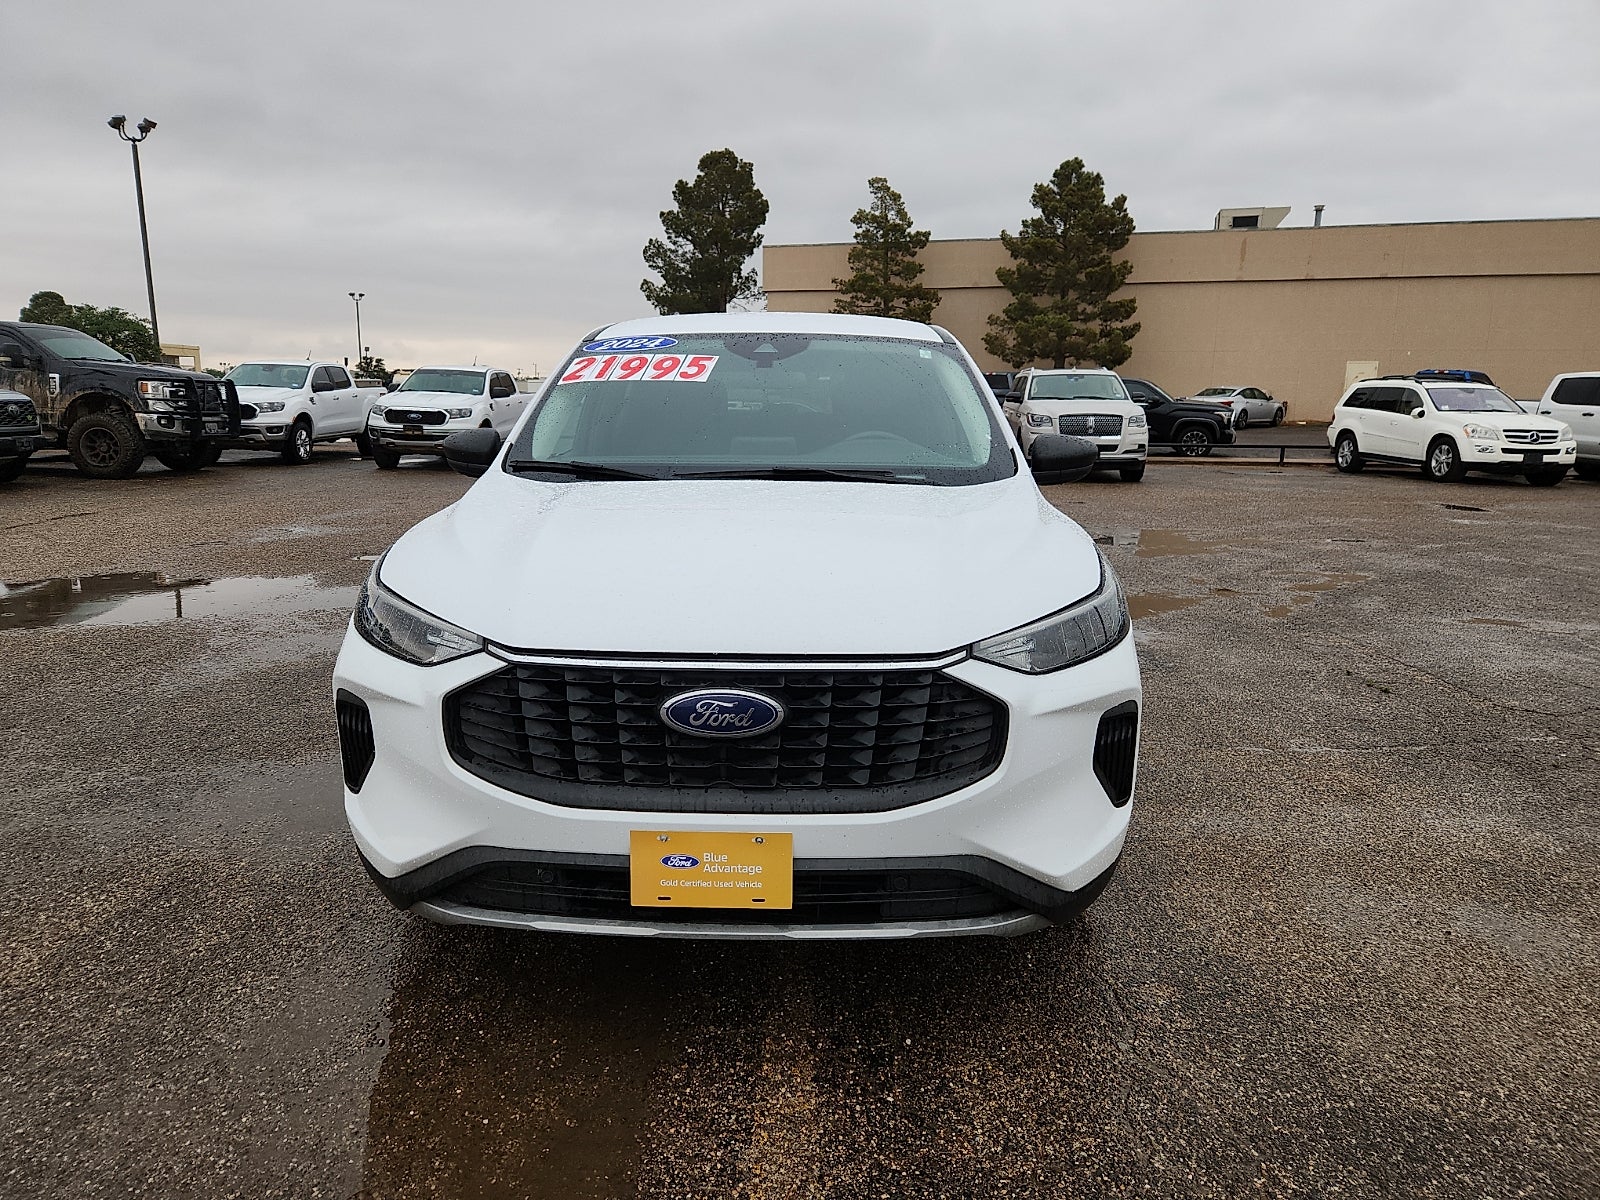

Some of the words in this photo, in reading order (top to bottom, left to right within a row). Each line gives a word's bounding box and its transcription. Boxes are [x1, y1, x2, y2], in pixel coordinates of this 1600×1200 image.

[596, 337, 661, 351] 2024
[561, 354, 715, 383] 21995
[689, 699, 755, 727] Ford
[667, 856, 692, 867] Ford
[703, 852, 728, 863] Blue
[703, 863, 762, 875] Advantage
[660, 878, 678, 887] Gold
[680, 879, 712, 888] Certified
[714, 880, 734, 888] Used
[735, 880, 762, 888] Vehicle
